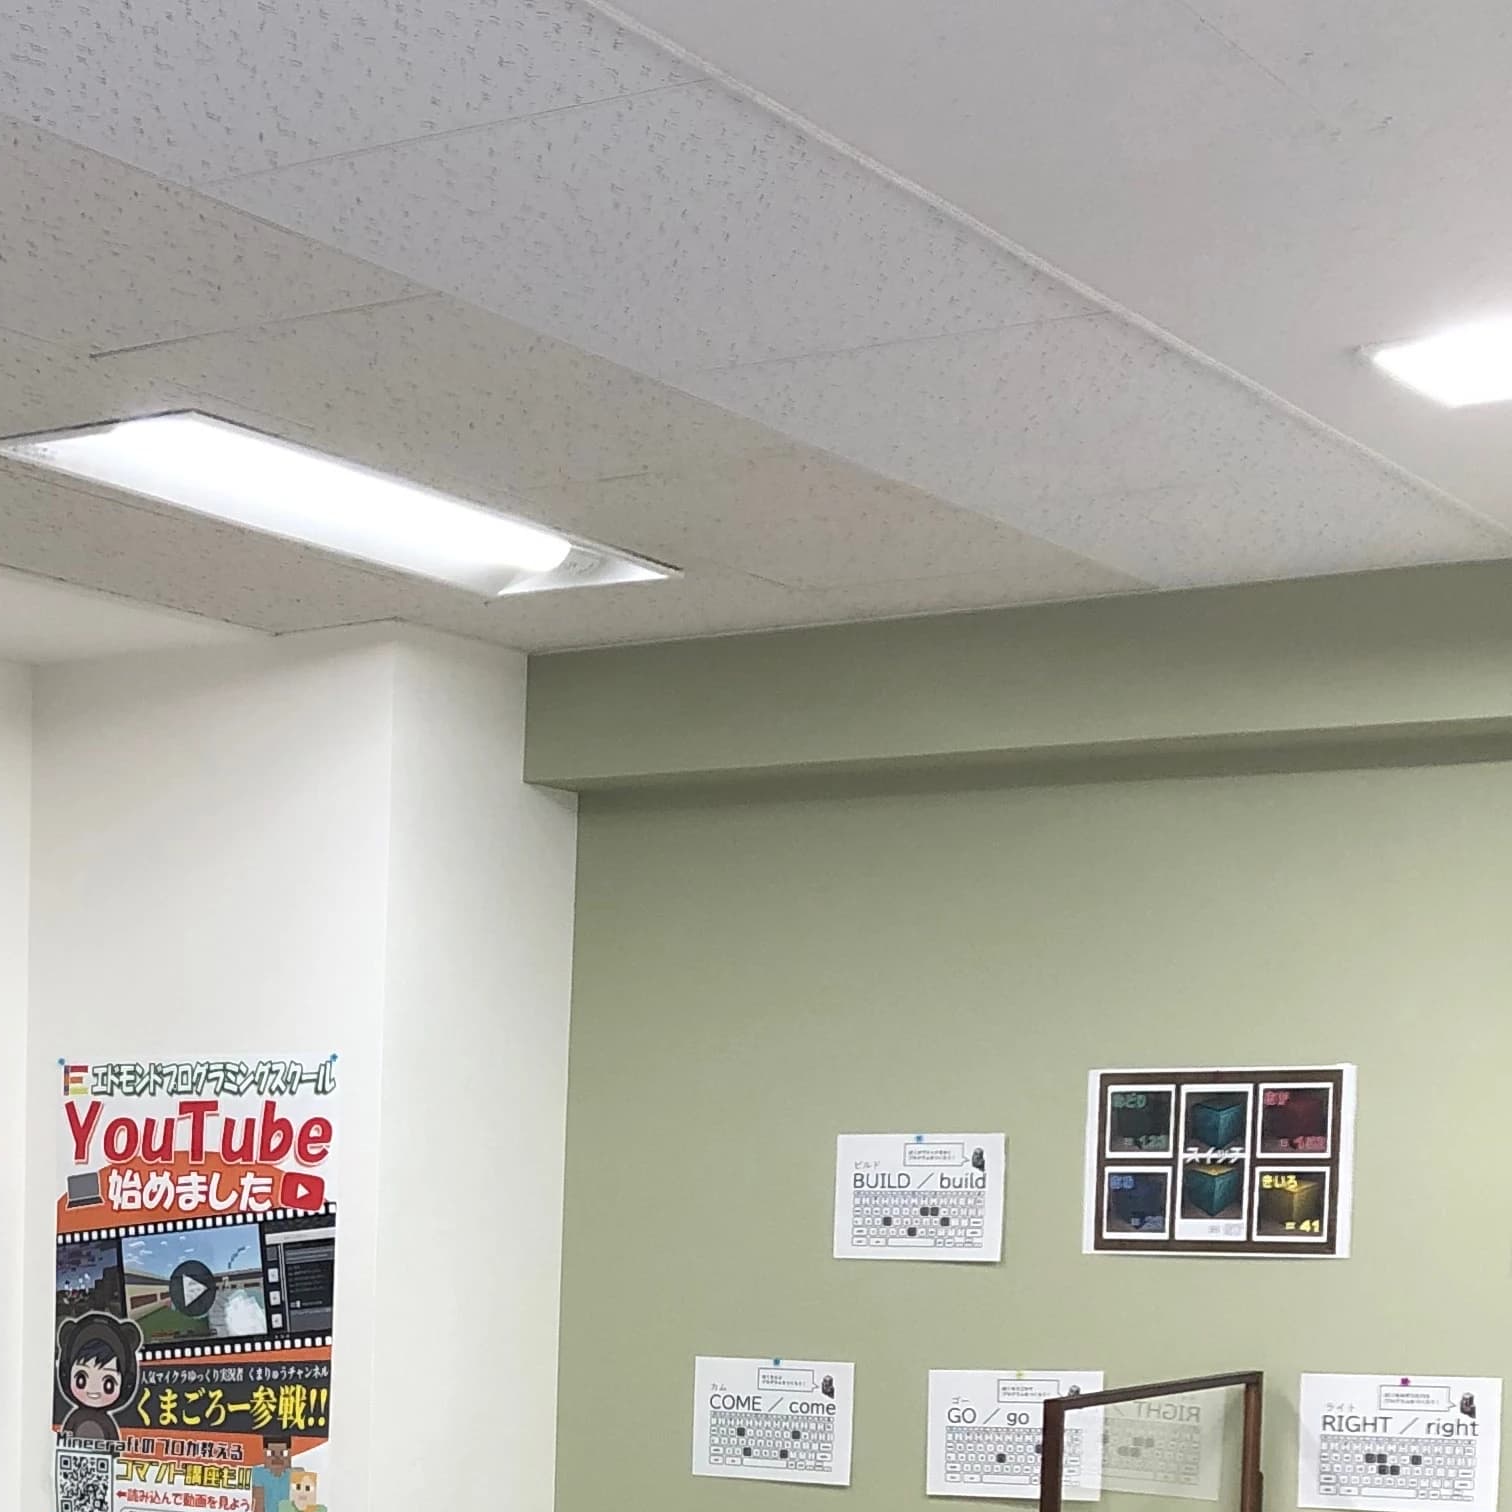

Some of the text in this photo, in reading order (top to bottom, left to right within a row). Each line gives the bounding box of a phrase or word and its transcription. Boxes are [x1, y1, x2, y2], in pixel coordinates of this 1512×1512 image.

[92, 1061, 336, 1096] エドモンドプログラミングスクール
[64, 1100, 333, 1164] YouTube
[108, 1169, 273, 1211] 始めました
[853, 1172, 911, 1189] BUILD
[940, 1172, 986, 1189] build
[1262, 1175, 1298, 1192] きいろ
[1300, 1219, 1320, 1232] 41
[709, 1394, 763, 1412] COME
[789, 1400, 836, 1415] come
[947, 1407, 977, 1424] GO
[1007, 1410, 1030, 1426] go
[1322, 1415, 1392, 1433] RIGHT
[1426, 1417, 1479, 1437] right
